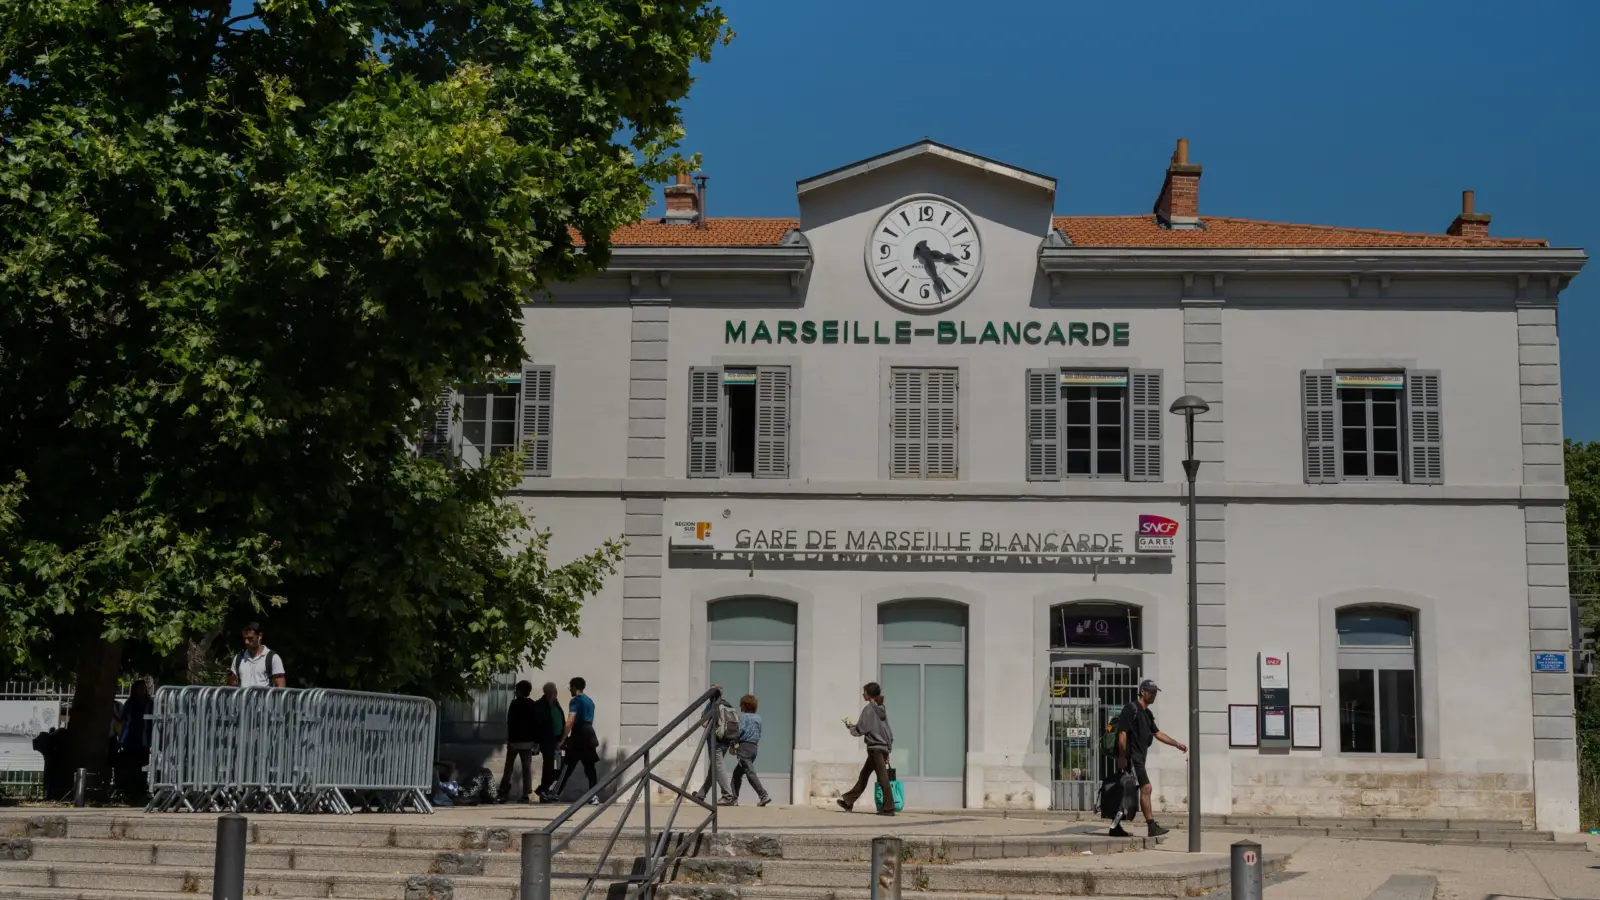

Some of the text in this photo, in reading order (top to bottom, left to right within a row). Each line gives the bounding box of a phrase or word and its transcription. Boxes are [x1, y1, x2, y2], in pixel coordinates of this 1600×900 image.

[918, 205, 934, 222] 12
[880, 244, 891, 260] 9
[960, 244, 971, 260] 3
[919, 283, 930, 299] 6
[1140, 522, 1176, 533] SNCF
[735, 529, 1124, 551] GARE DE MARSEILLE BLANCARDE
